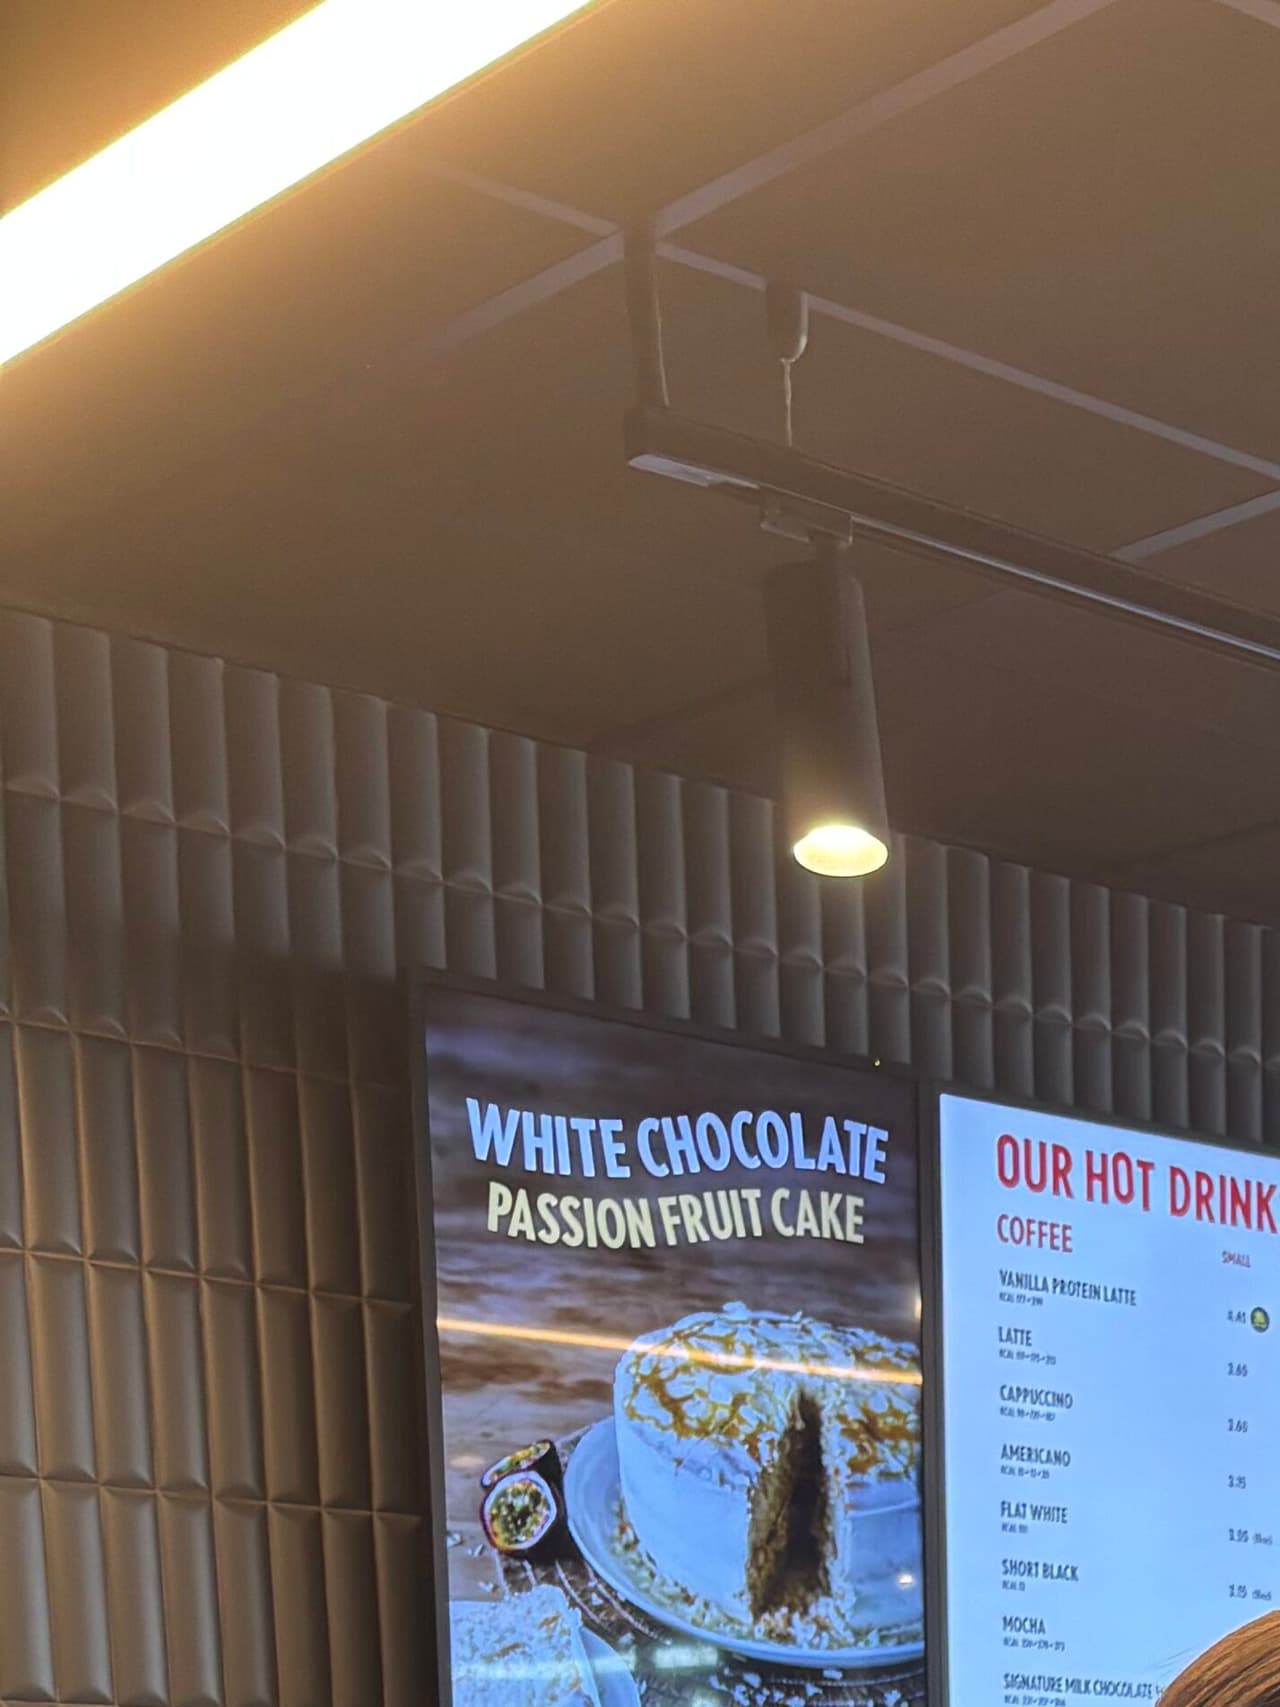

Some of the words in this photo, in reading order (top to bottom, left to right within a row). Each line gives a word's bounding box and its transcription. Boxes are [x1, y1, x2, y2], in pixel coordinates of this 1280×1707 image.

[465, 1096, 632, 1181] WHITE
[636, 1111, 889, 1186] CHOCOLATE
[996, 1134, 1073, 1198] OUR
[1086, 1149, 1155, 1212] HOT
[485, 1180, 658, 1251] PASSION
[660, 1186, 763, 1248] FRUIT
[772, 1183, 866, 1247] CAKE
[997, 1214, 1073, 1254] COFFEE
[1222, 1250, 1251, 1268] SMALL
[999, 1269, 1049, 1293] VANILLA
[1052, 1277, 1101, 1300] PROTEIN
[1103, 1286, 1136, 1306] LATTE
[998, 1326, 1032, 1347] LATTE
[1000, 1384, 1073, 1409] CAPPUCCINO
[1000, 1444, 1071, 1467] AMERICANO
[1000, 1500, 1027, 1519] FLAT
[1030, 1503, 1068, 1524] WHITE
[1002, 1558, 1039, 1578] SHORT
[1042, 1562, 1079, 1582] BLACK
[1002, 1615, 1046, 1635] MOCHA
[1003, 1673, 1063, 1693] SIGNATURE
[1065, 1679, 1092, 1695] MILK
[1093, 1681, 1153, 1699] CHOCOLATE
